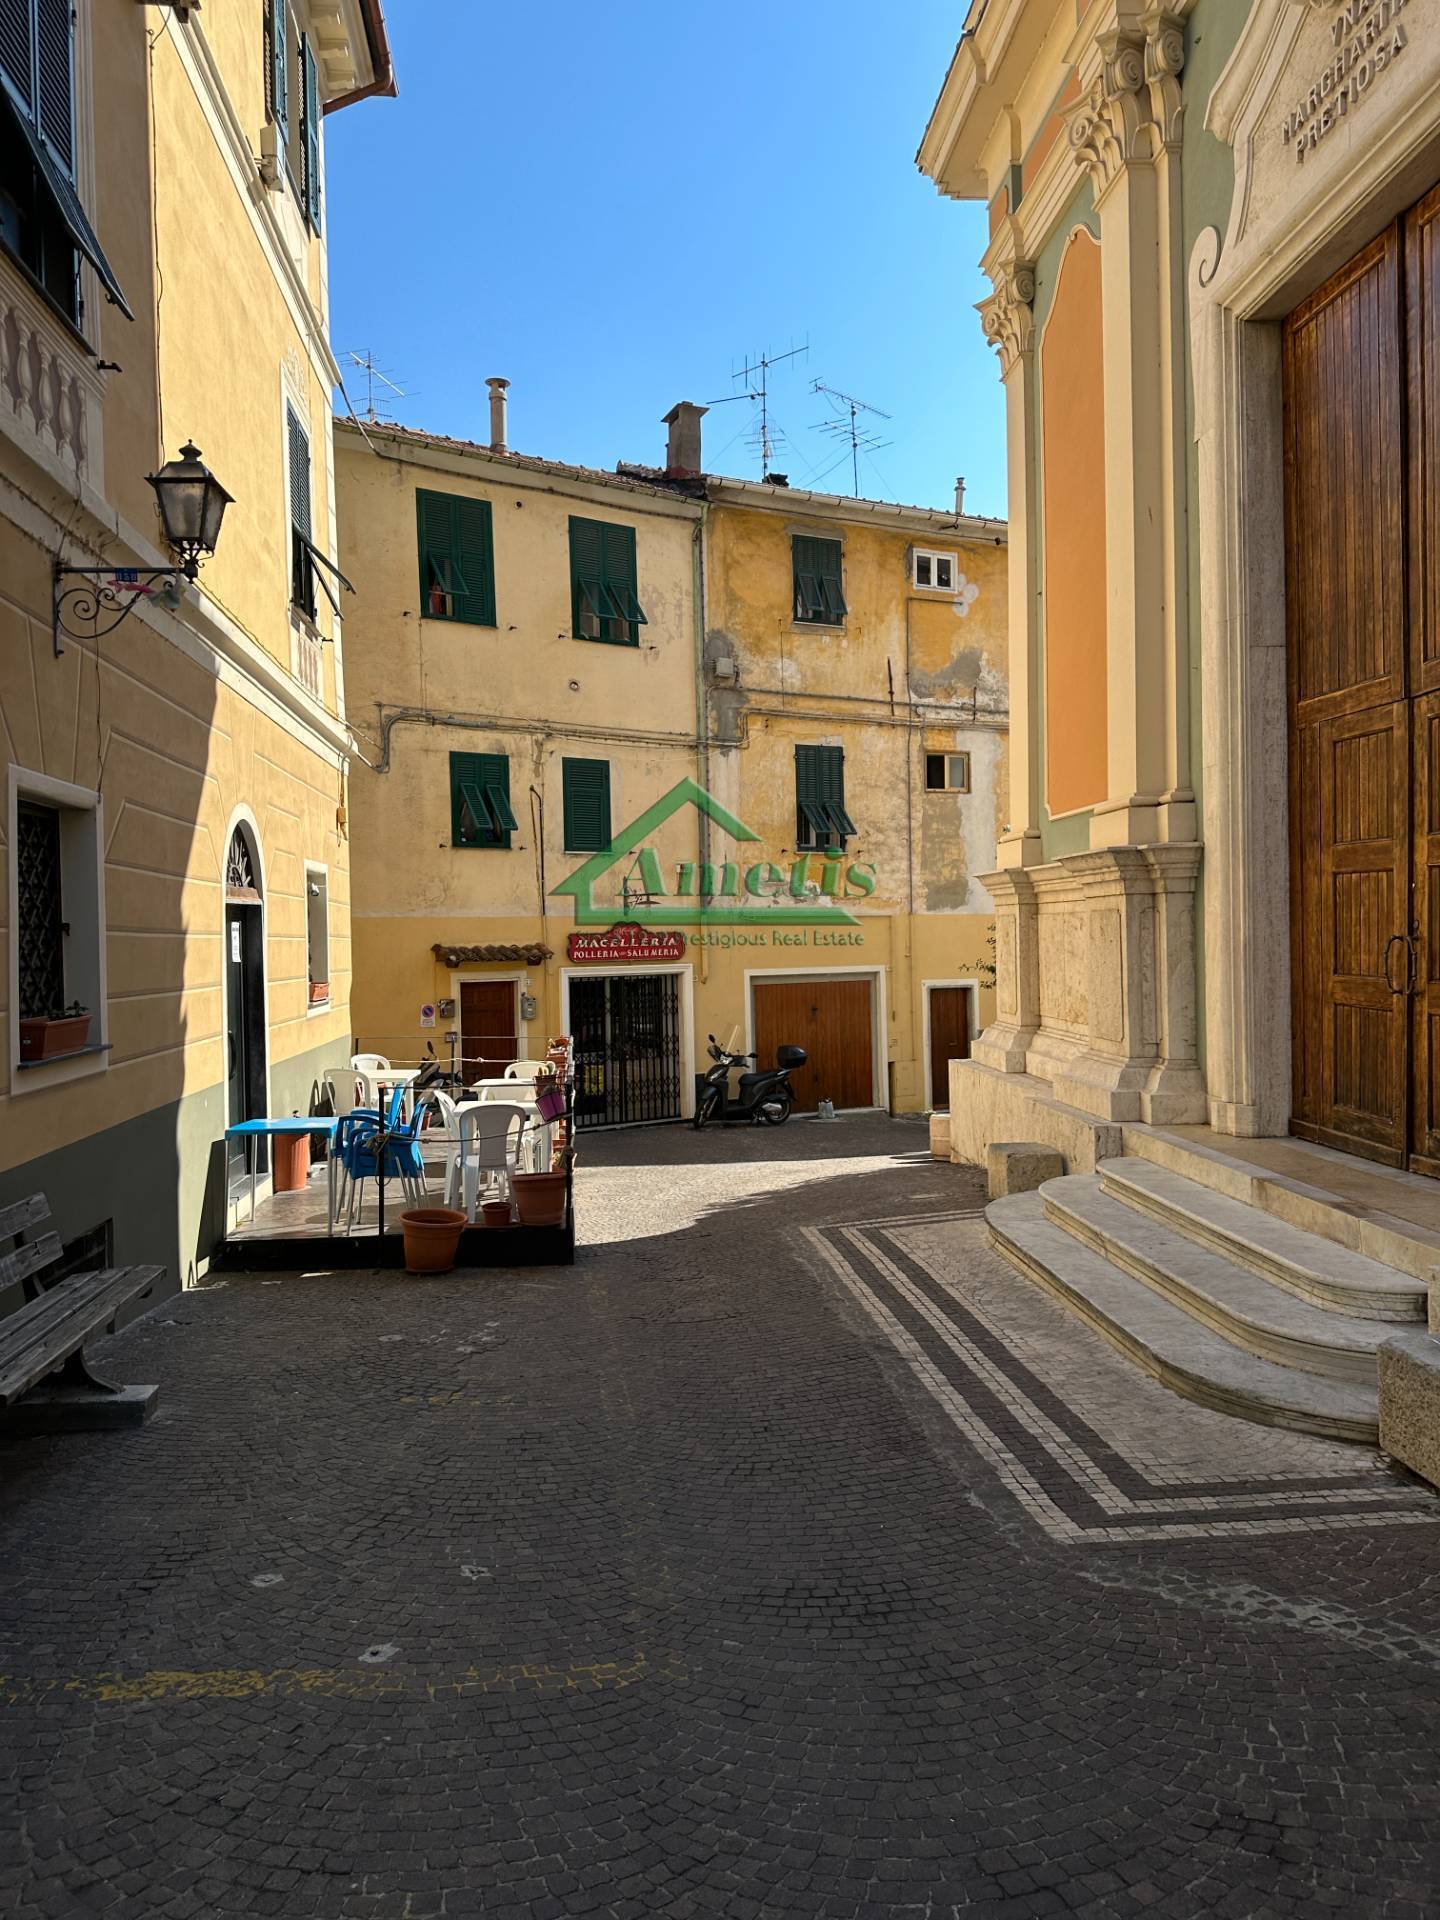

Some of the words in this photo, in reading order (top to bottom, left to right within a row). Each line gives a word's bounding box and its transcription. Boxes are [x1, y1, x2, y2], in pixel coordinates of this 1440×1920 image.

[1296, 24, 1408, 164] PRETIOSA
[575, 937, 677, 948] MACELLERIA
[573, 950, 619, 959] POLLERIA
[627, 948, 679, 958] SALUMERIA
